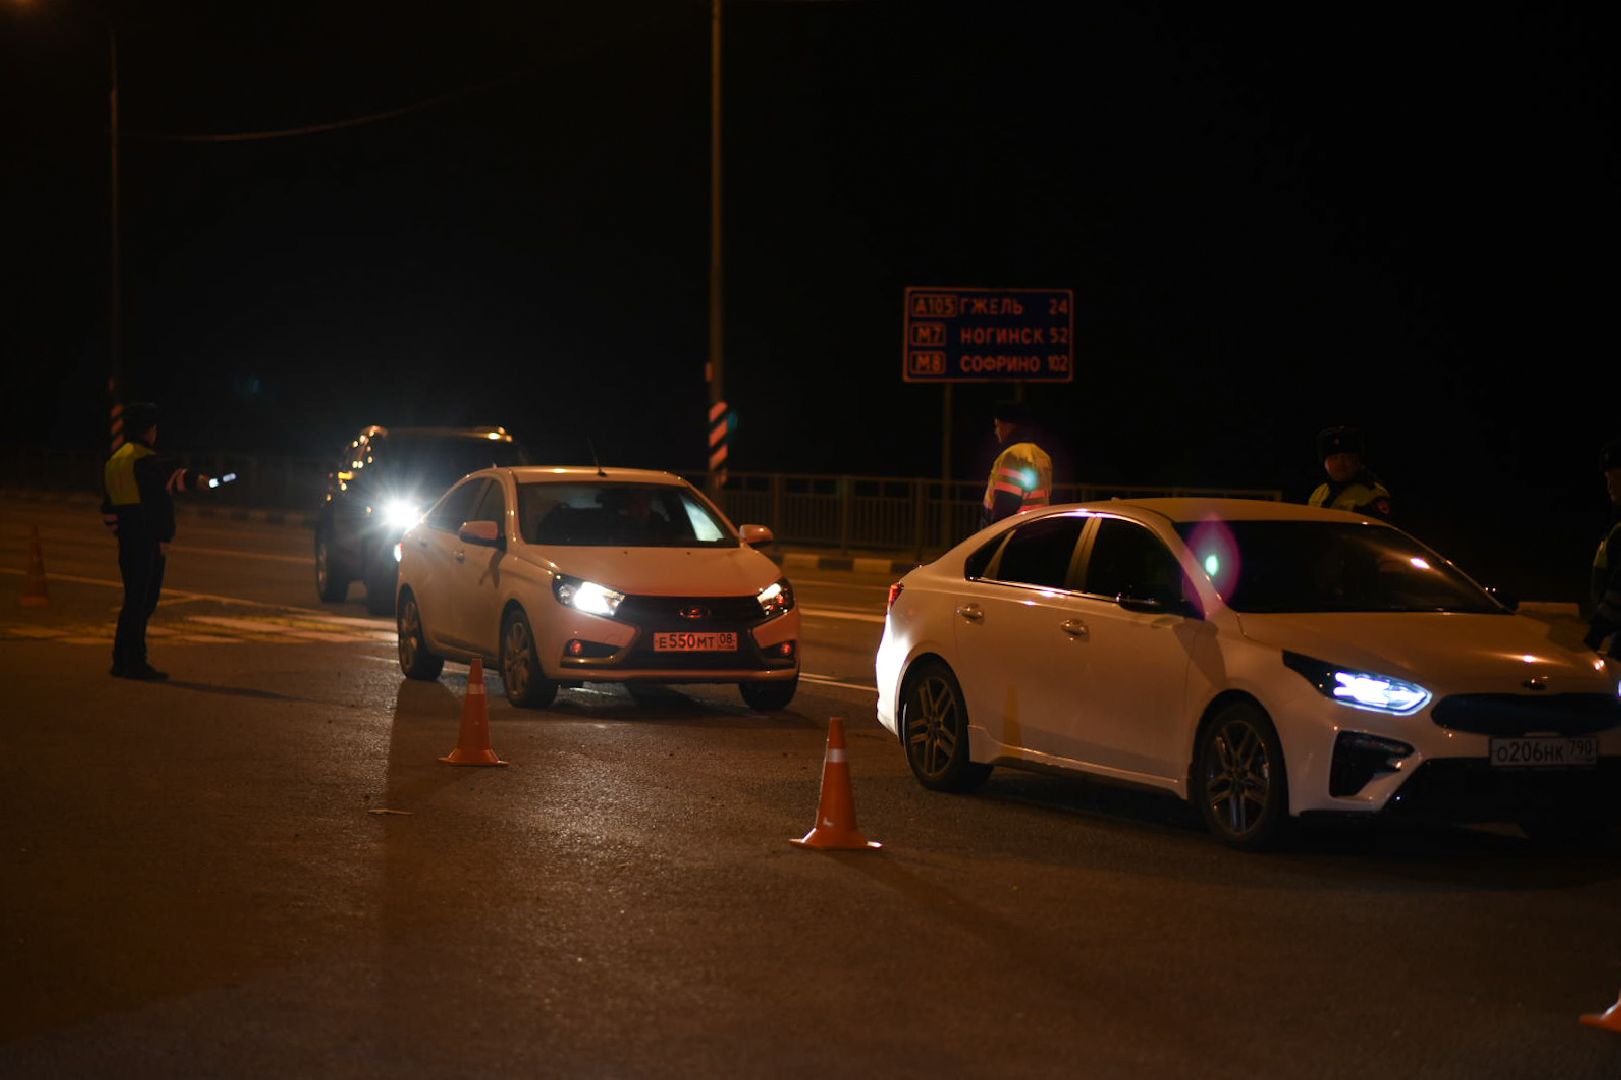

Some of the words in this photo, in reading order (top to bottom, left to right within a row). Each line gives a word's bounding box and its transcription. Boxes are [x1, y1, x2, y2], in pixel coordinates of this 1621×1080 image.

[959, 297, 1025, 316] ГЖЕЛЬ
[1048, 297, 1069, 316] 24
[916, 327, 942, 344] М7
[959, 327, 1044, 345] НОГИНСК
[1050, 327, 1069, 344] 52
[915, 353, 942, 371] М8
[959, 354, 1042, 372] СОФРИНО
[1047, 354, 1069, 372] 102
